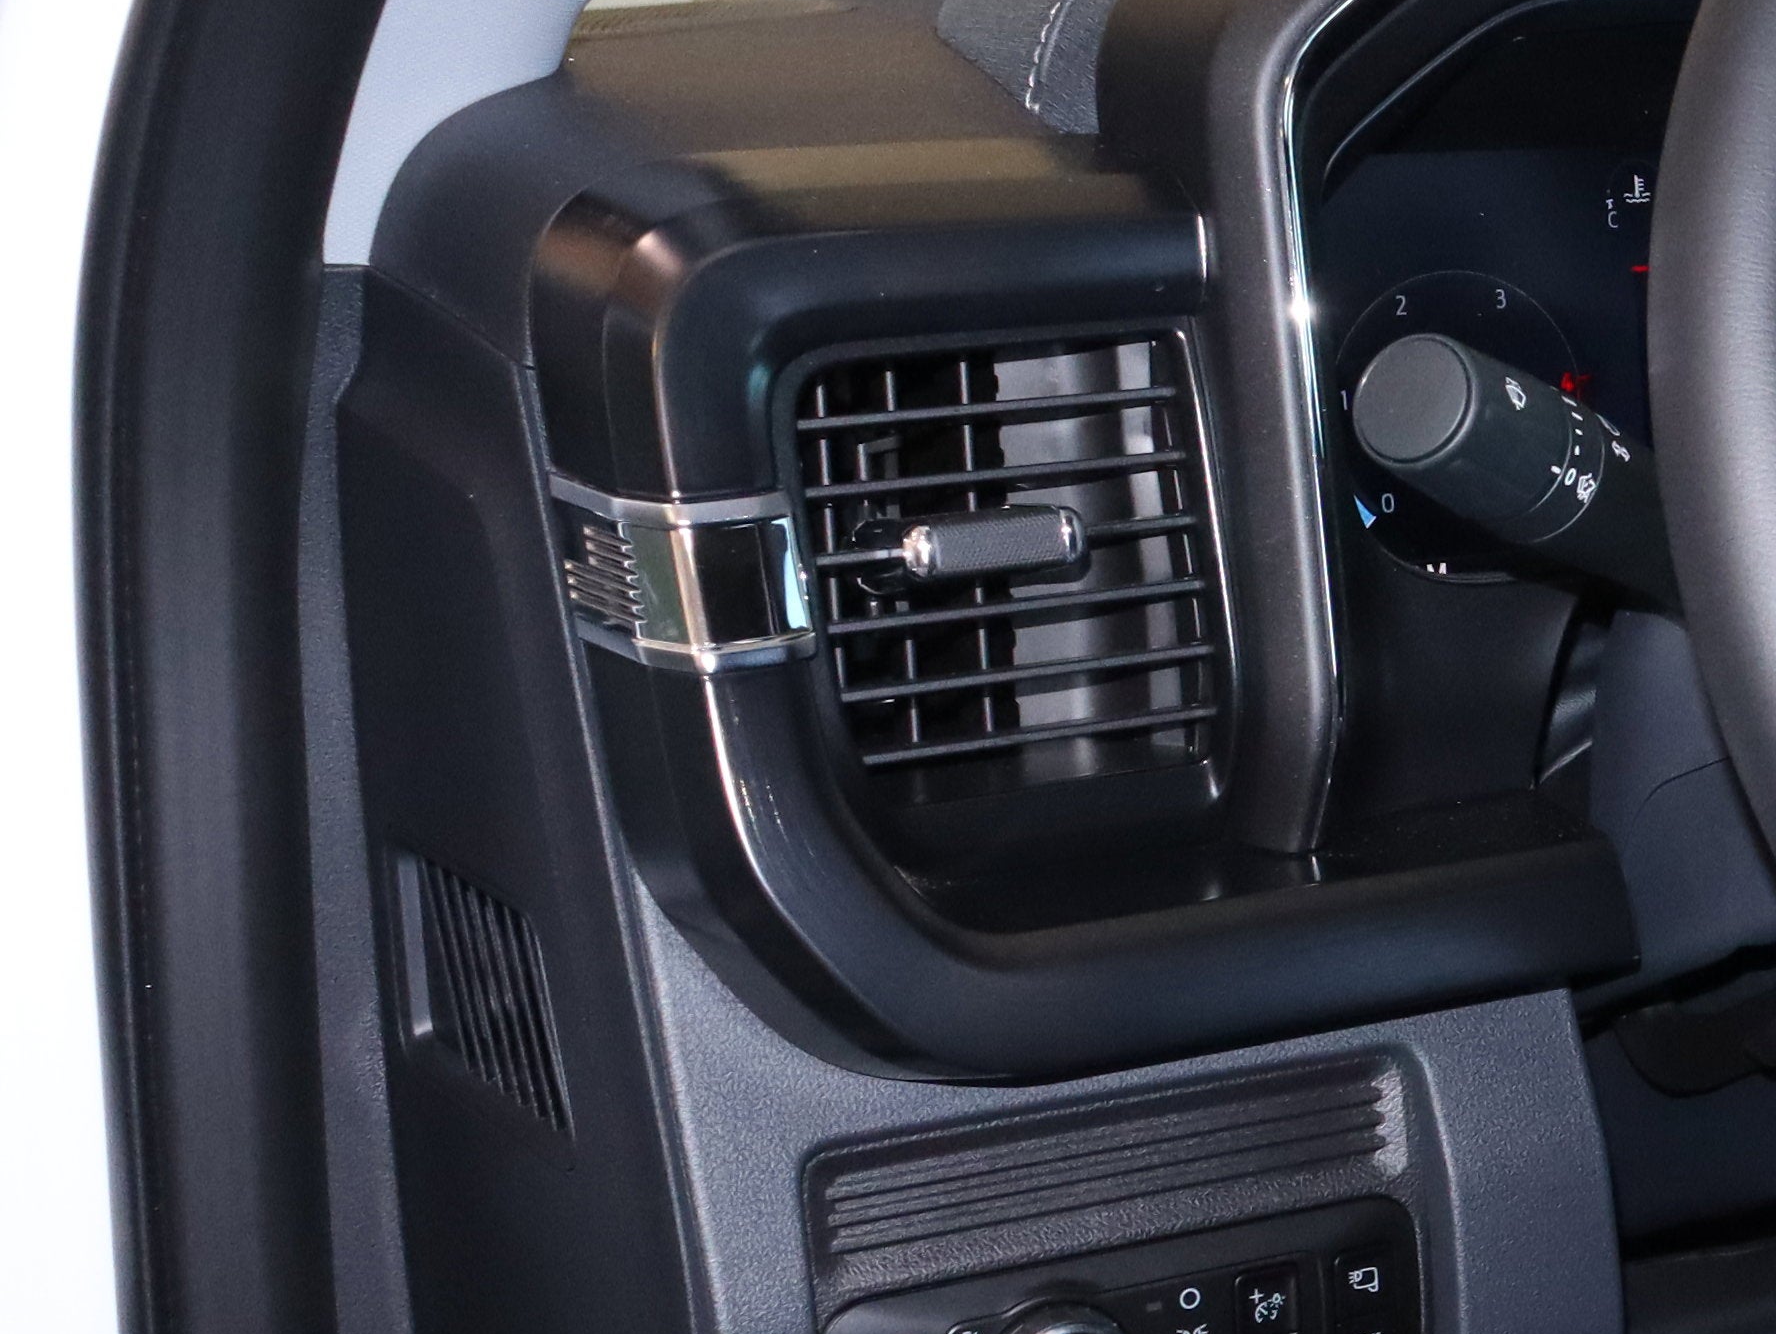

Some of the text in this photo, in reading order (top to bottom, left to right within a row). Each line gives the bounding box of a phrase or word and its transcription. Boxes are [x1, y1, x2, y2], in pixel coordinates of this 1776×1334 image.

[1395, 294, 1408, 317] 2
[1495, 288, 1507, 310] 3
[1381, 492, 1395, 514] 0
